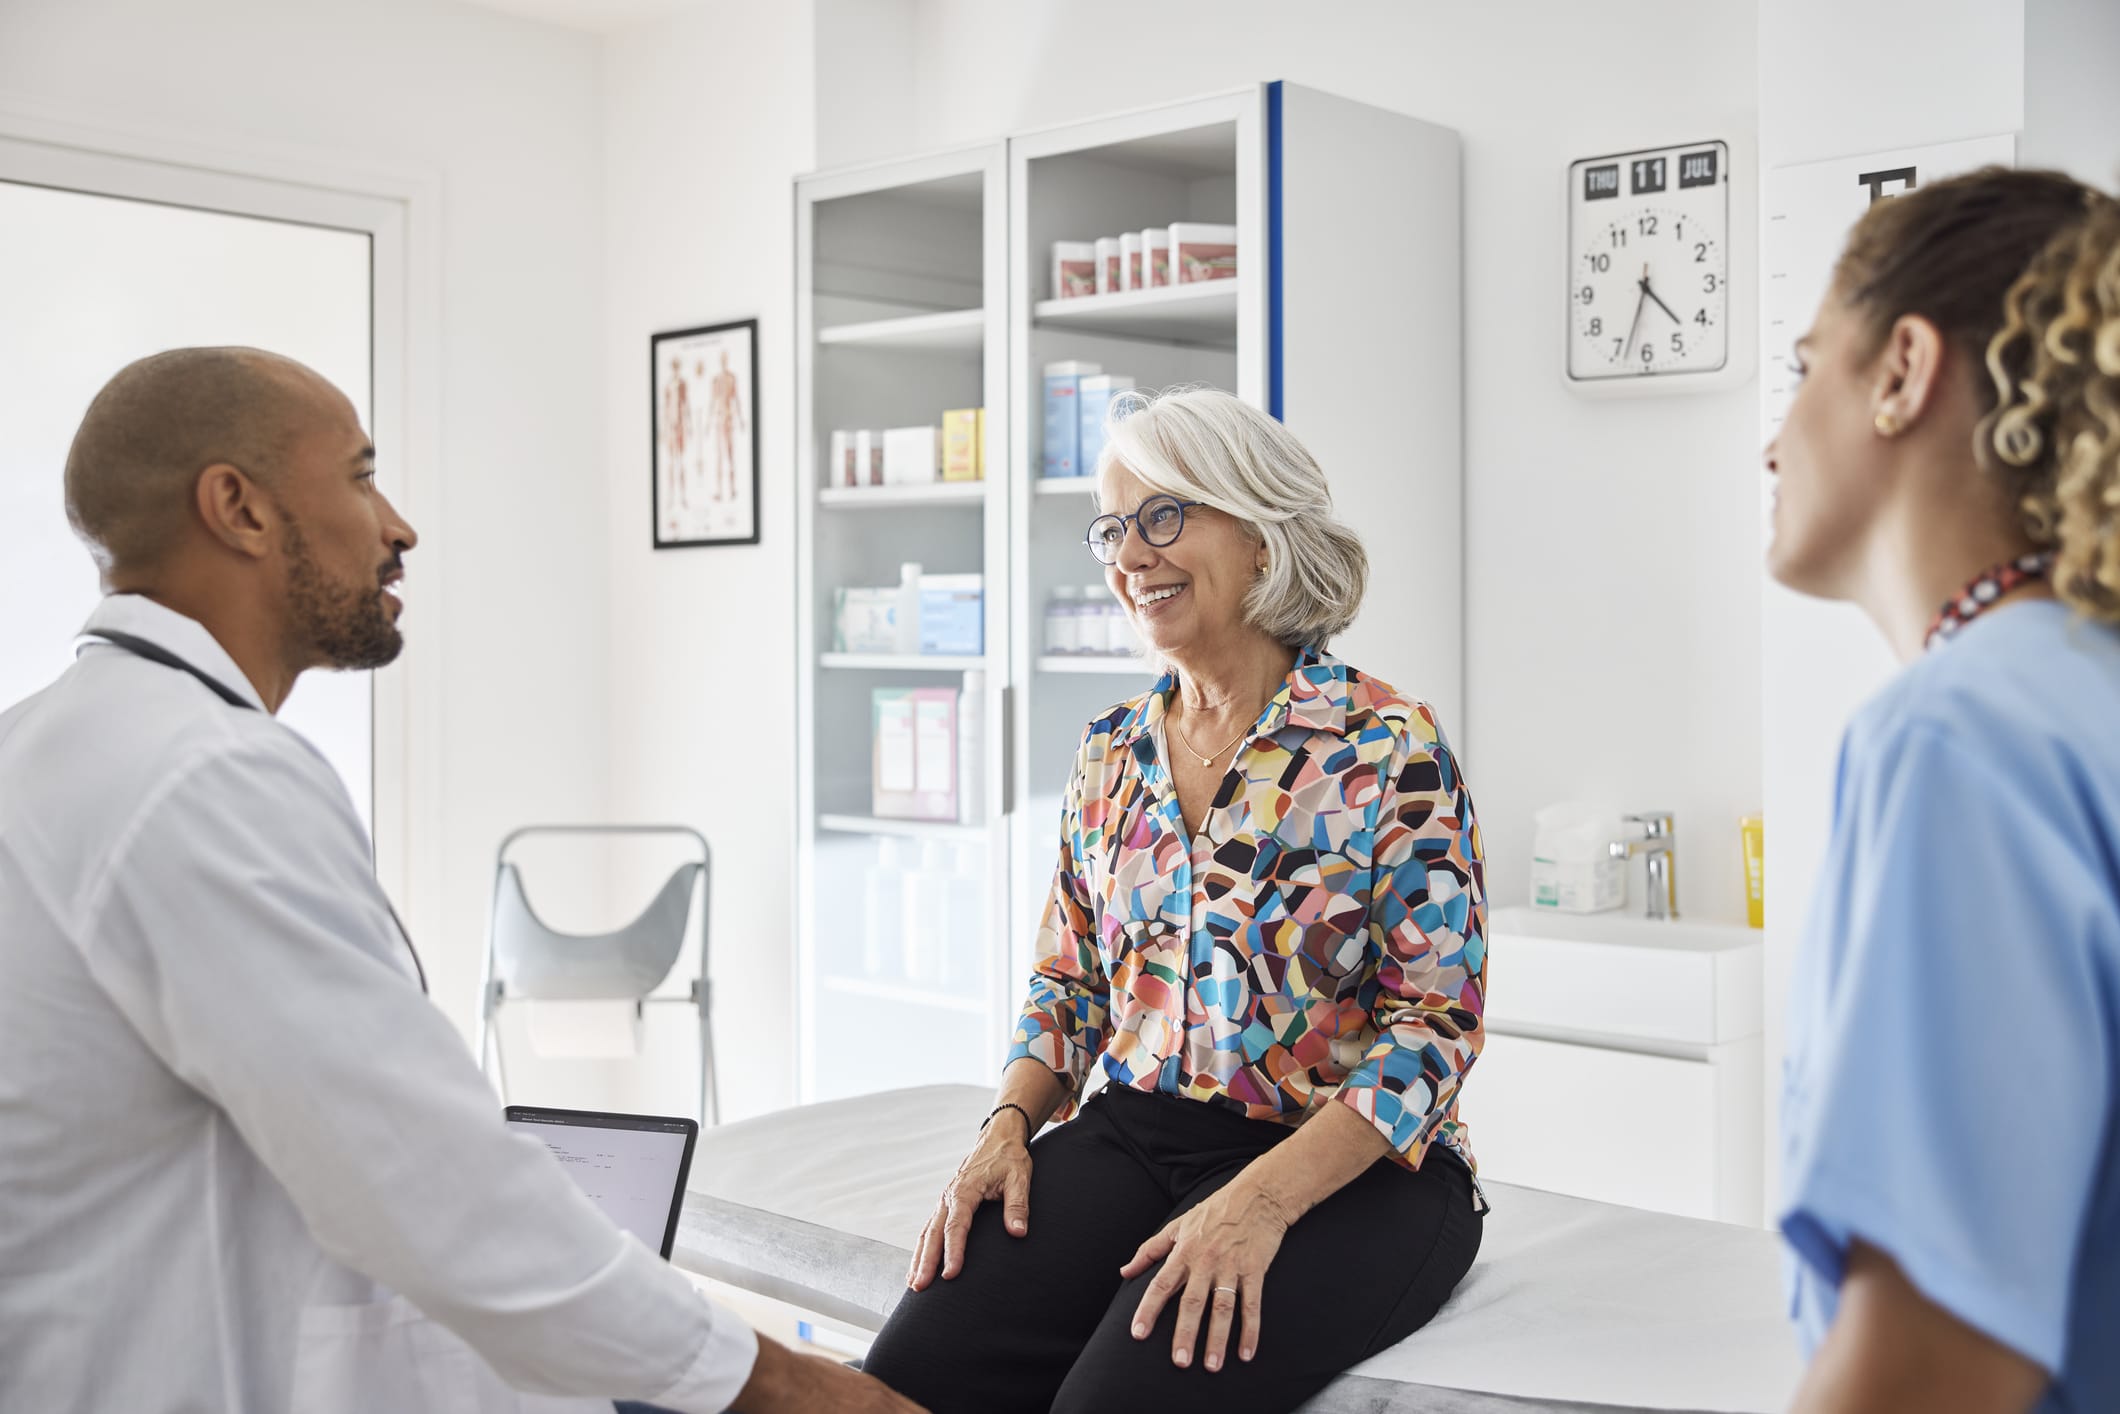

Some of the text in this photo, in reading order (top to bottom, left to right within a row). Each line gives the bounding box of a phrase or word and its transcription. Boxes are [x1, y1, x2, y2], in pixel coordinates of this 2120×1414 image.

[1588, 157, 1712, 192] THU 11 JUL
[1639, 216, 1658, 236] 12
[1675, 222, 1682, 241] 1
[1611, 229, 1627, 248] 11
[1694, 243, 1707, 263] 2
[1590, 254, 1610, 273] 10
[1704, 274, 1716, 293] 3
[1581, 286, 1594, 305] 9
[1694, 308, 1707, 327] 4
[1590, 318, 1603, 337] 8
[1612, 337, 1624, 358] 7
[1671, 333, 1683, 353] 5
[1641, 344, 1653, 363] 6
